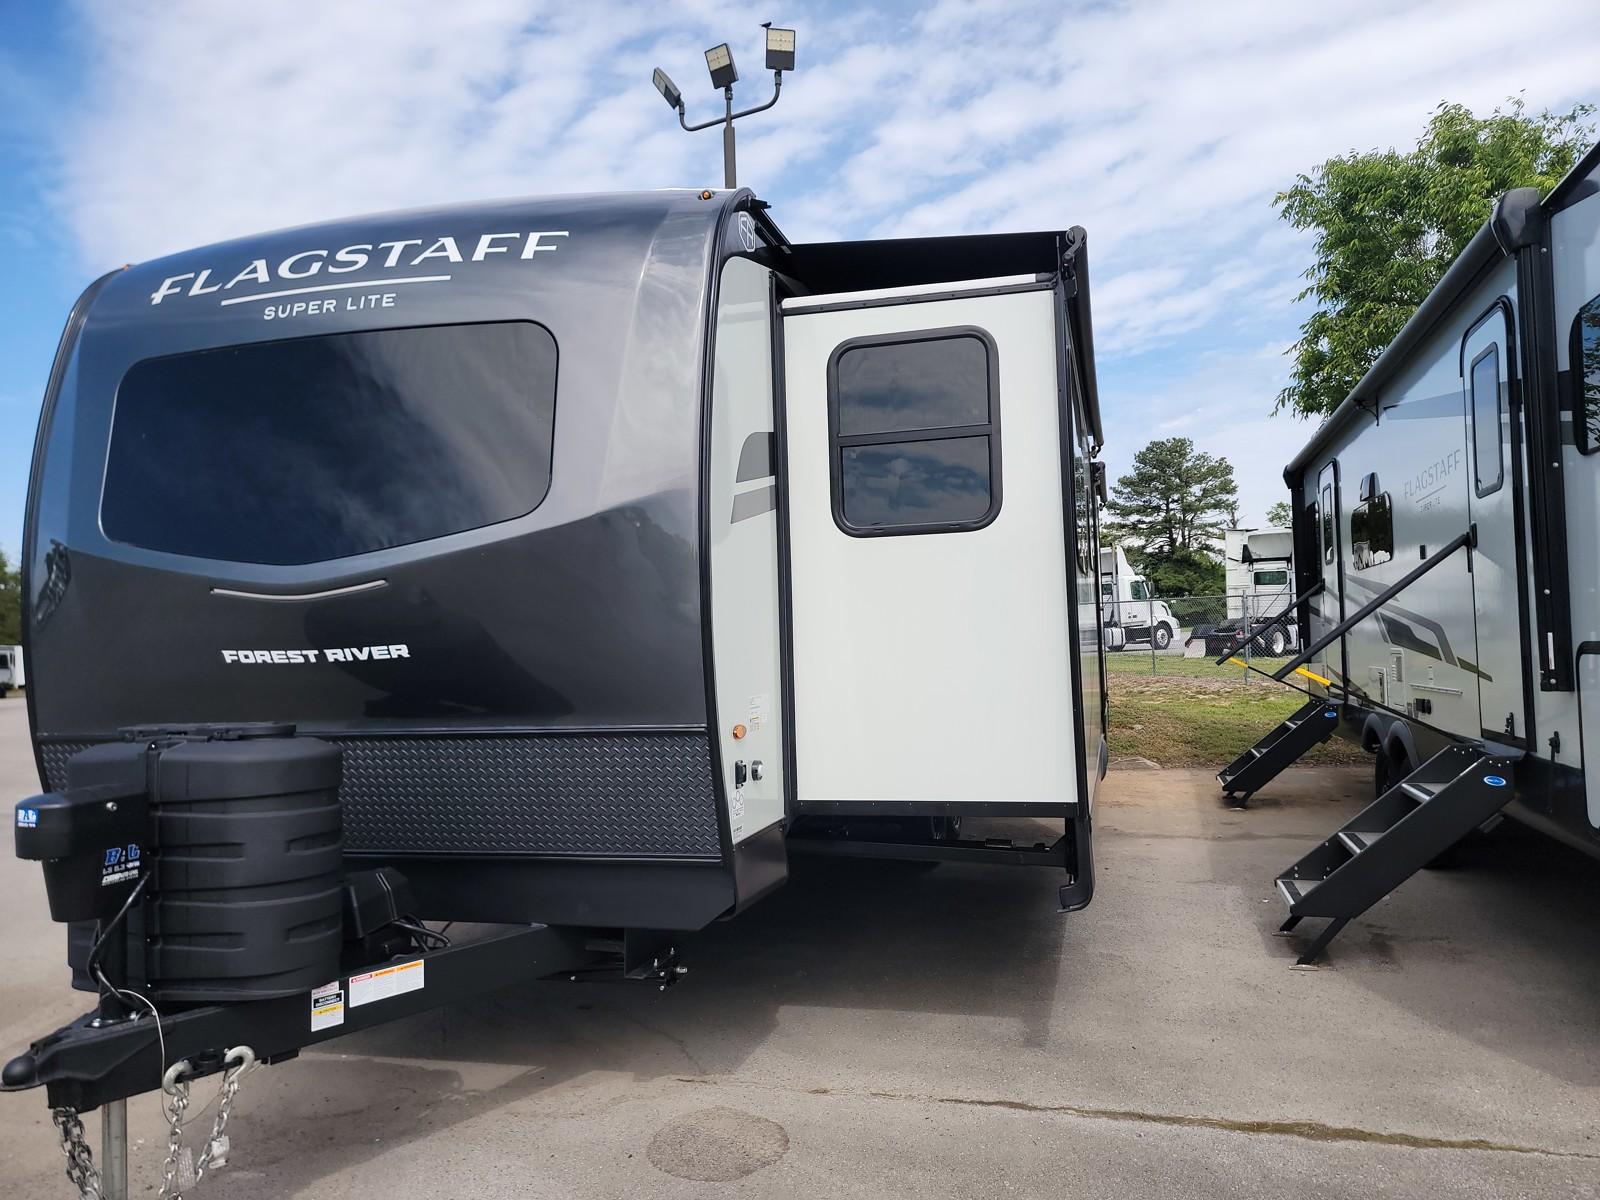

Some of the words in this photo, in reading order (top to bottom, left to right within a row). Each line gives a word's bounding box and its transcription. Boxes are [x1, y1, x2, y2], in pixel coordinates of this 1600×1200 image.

[150, 230, 570, 306] FLAGSTAFF
[263, 299, 337, 320] SUPER
[346, 293, 396, 312] LITE
[1403, 448, 1461, 500] FLAGSTAFF
[221, 649, 320, 664] FOREST
[323, 644, 411, 663] RIVER
